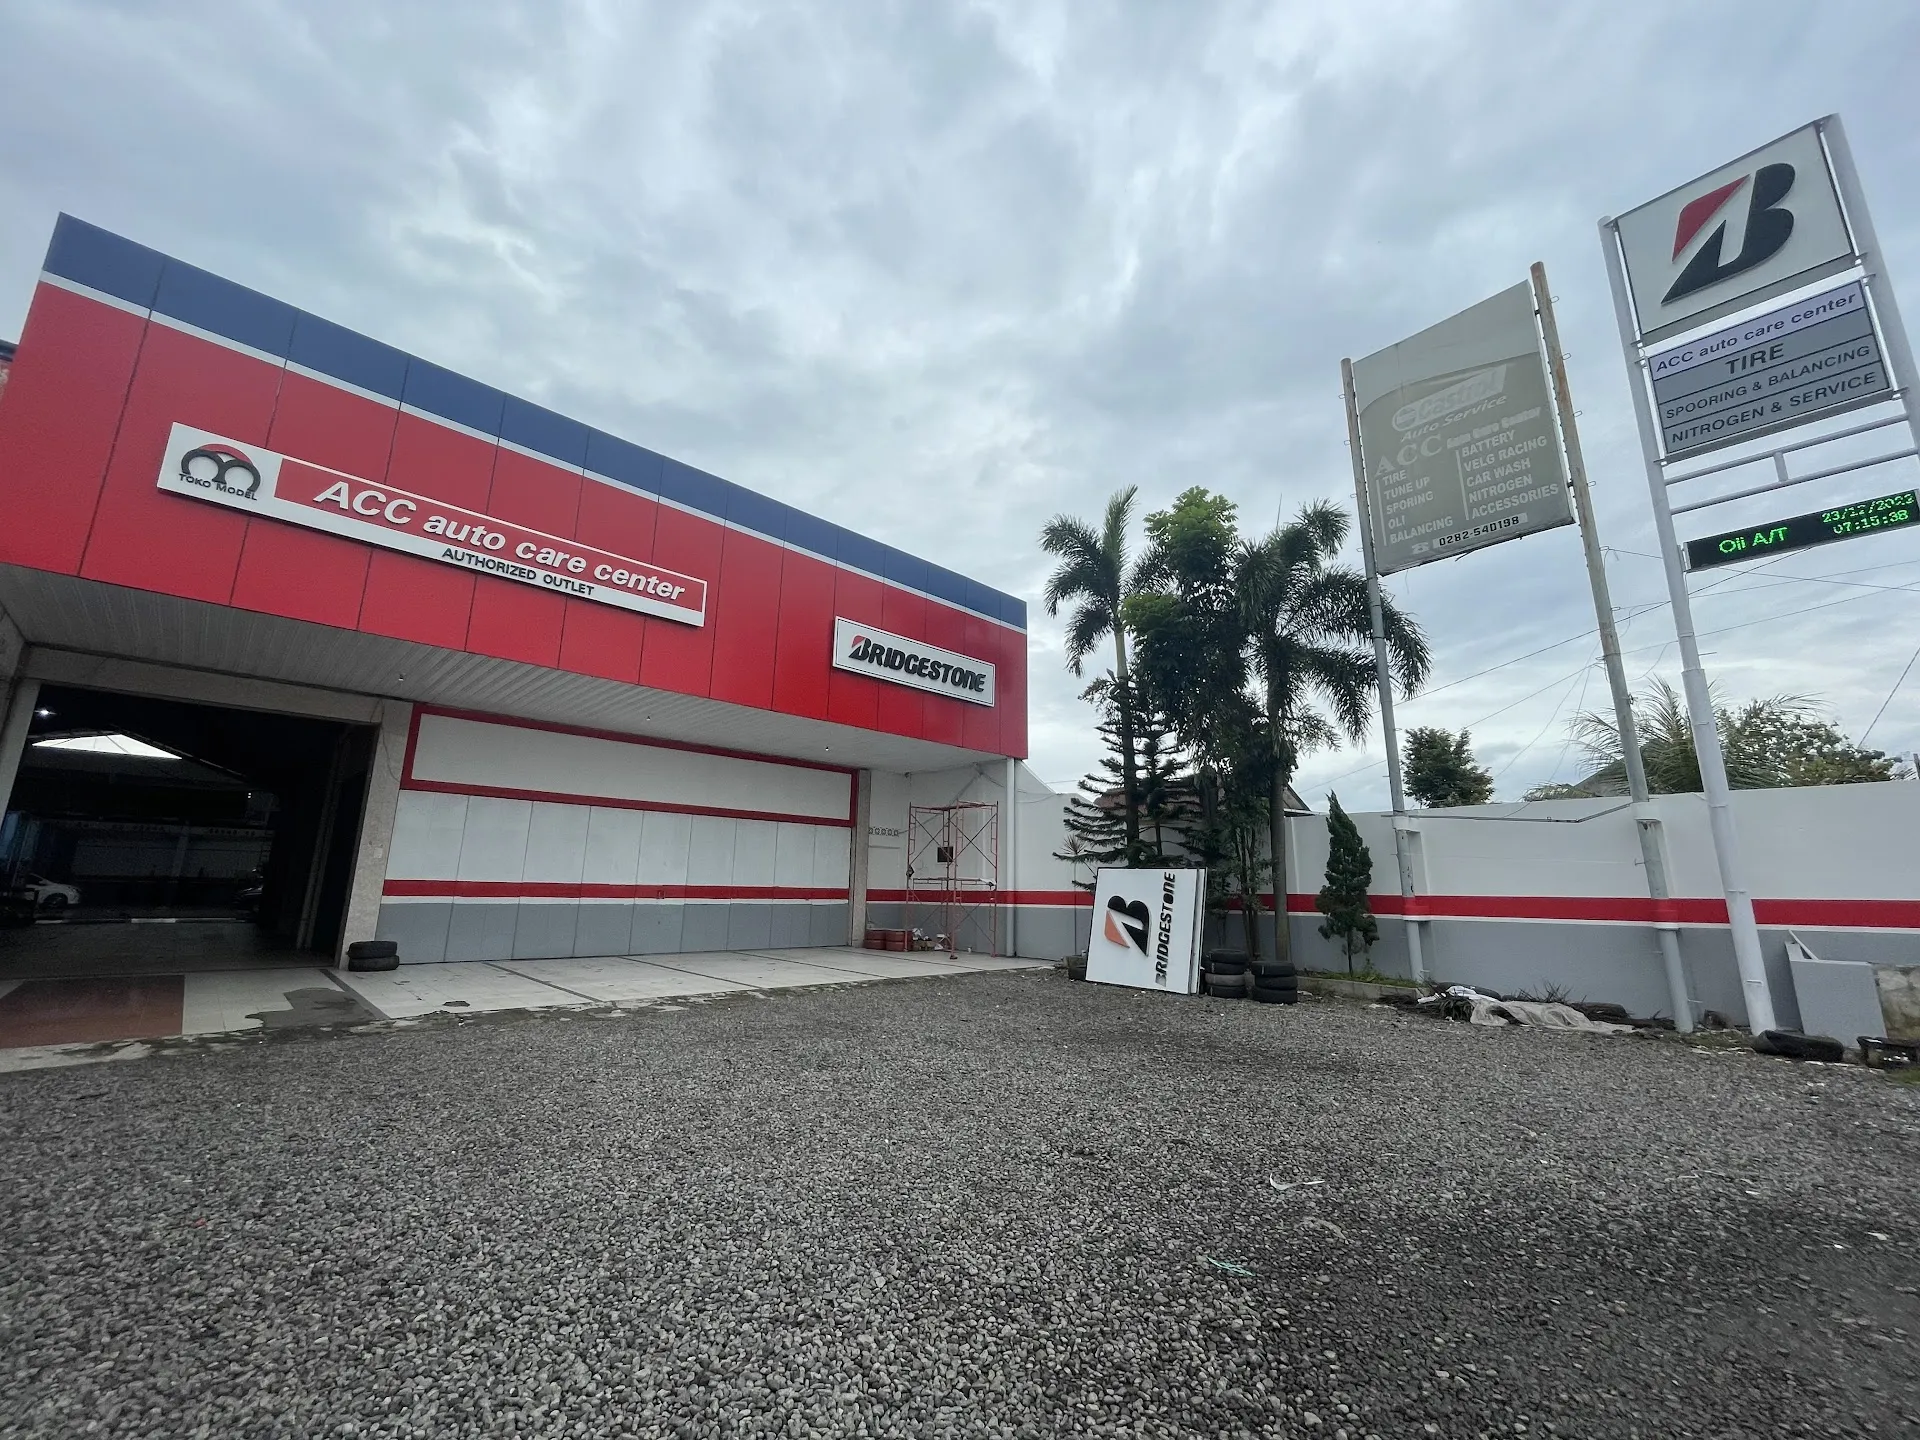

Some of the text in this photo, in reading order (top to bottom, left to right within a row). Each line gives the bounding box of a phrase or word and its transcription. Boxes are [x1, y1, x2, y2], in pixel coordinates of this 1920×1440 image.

[1656, 293, 1856, 373] ACC auto care center
[1725, 342, 1785, 375] TIRE
[1666, 386, 1748, 420] SPOORING
[1768, 344, 1871, 387] BALANCING
[1400, 421, 1438, 443] Auto
[1441, 395, 1507, 427] Service
[1671, 405, 1765, 444] NITROGEN
[1789, 371, 1877, 408] SERVICE
[1375, 433, 1443, 476] ACC
[1461, 429, 1516, 458] BATTERY
[1464, 434, 1548, 473] VELG RACING
[178, 472, 258, 501] TOKO MODEL
[1381, 468, 1407, 487] TIRE
[1383, 475, 1431, 501] TUNE UP
[1466, 456, 1532, 488] CAR WASH
[1468, 473, 1534, 504] NITROGEN
[1386, 490, 1434, 515] SPORING
[1471, 482, 1560, 520] ACCESSORIES
[1387, 514, 1406, 531] OLI
[1389, 515, 1454, 545] BALANCING
[1438, 514, 1520, 547] 0282-540198
[312, 480, 687, 603] ACC auto care center
[440, 546, 595, 597] AUTHORIZED OUTLET
[848, 634, 987, 693] BRIDGESTONE
[1155, 871, 1176, 988] BRIDGESTONE
